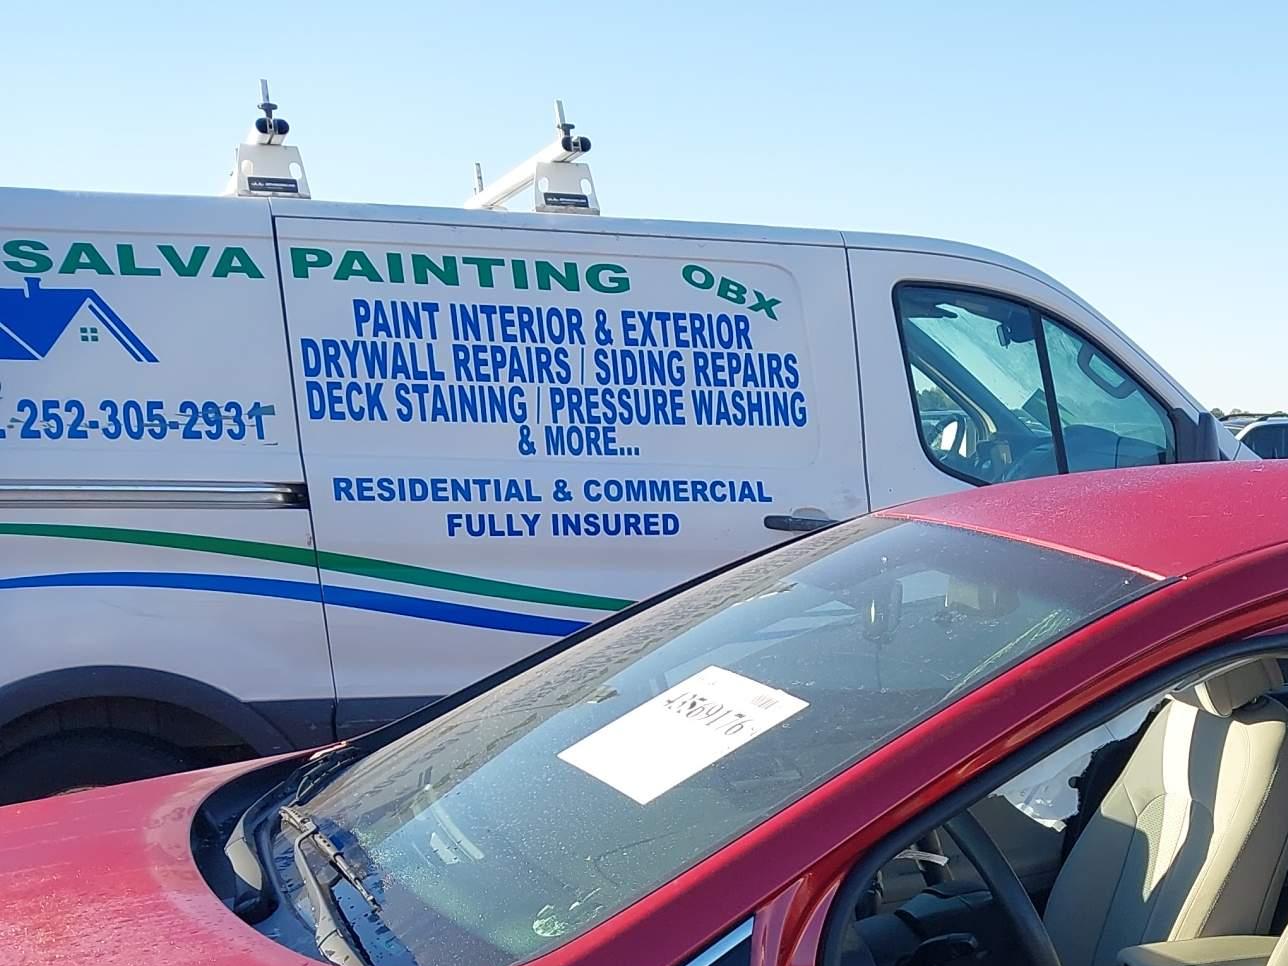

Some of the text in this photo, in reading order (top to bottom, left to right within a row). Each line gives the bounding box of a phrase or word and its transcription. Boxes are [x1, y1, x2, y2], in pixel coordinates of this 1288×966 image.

[2, 239, 782, 321] SALVA PAINTING OBX
[352, 298, 753, 350] PAINT INTERIOR & EXTERIOR
[300, 337, 446, 382] DRYWALL
[451, 343, 572, 386] REPAIRS
[593, 347, 686, 387] SIDING
[692, 350, 801, 390] REPAIRS
[305, 380, 388, 423] DECK
[394, 382, 528, 424] STAINING
[549, 387, 686, 426] PRESSURE
[691, 389, 808, 428] WASHING
[518, 424, 641, 457] & MORE...
[332, 477, 774, 503] RESIDENTIAL & COMMERCIAL
[446, 513, 681, 537] FULLY INSURED
